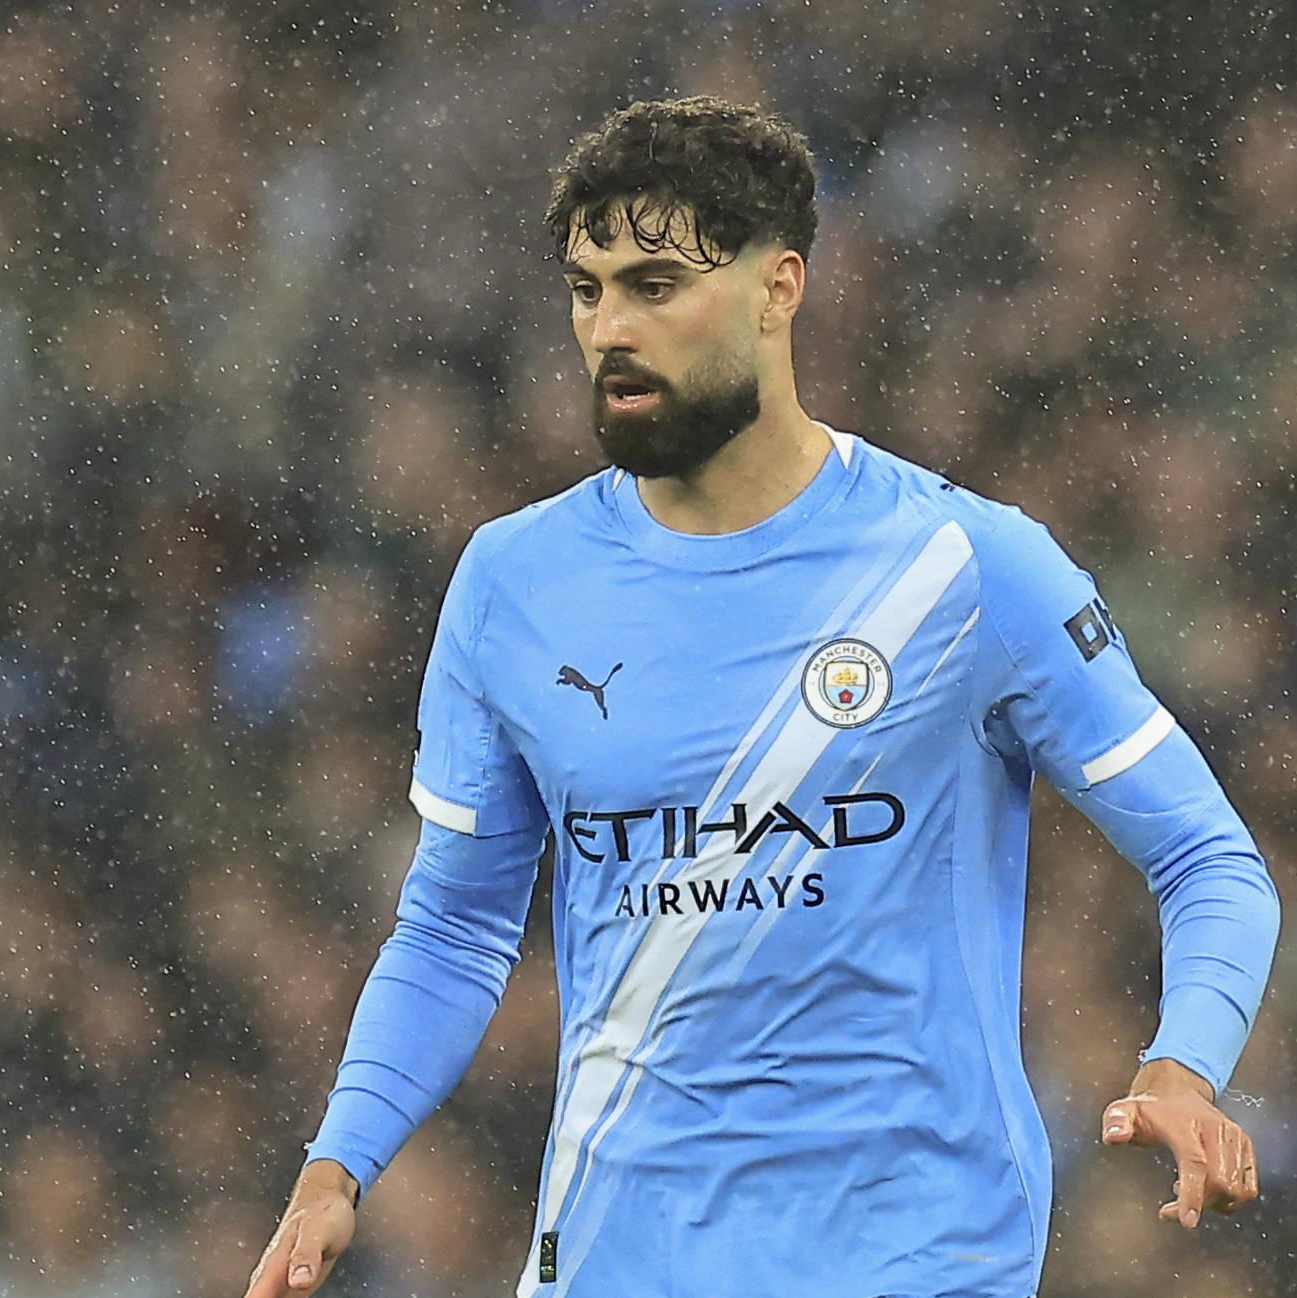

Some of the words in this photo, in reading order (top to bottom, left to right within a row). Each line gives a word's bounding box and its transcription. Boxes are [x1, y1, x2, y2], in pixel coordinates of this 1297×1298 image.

[813, 646, 882, 672] MANCHESTER
[833, 713, 858, 721] CITY
[564, 792, 905, 863] ETIHAD
[615, 873, 825, 917] AIRWAYS
